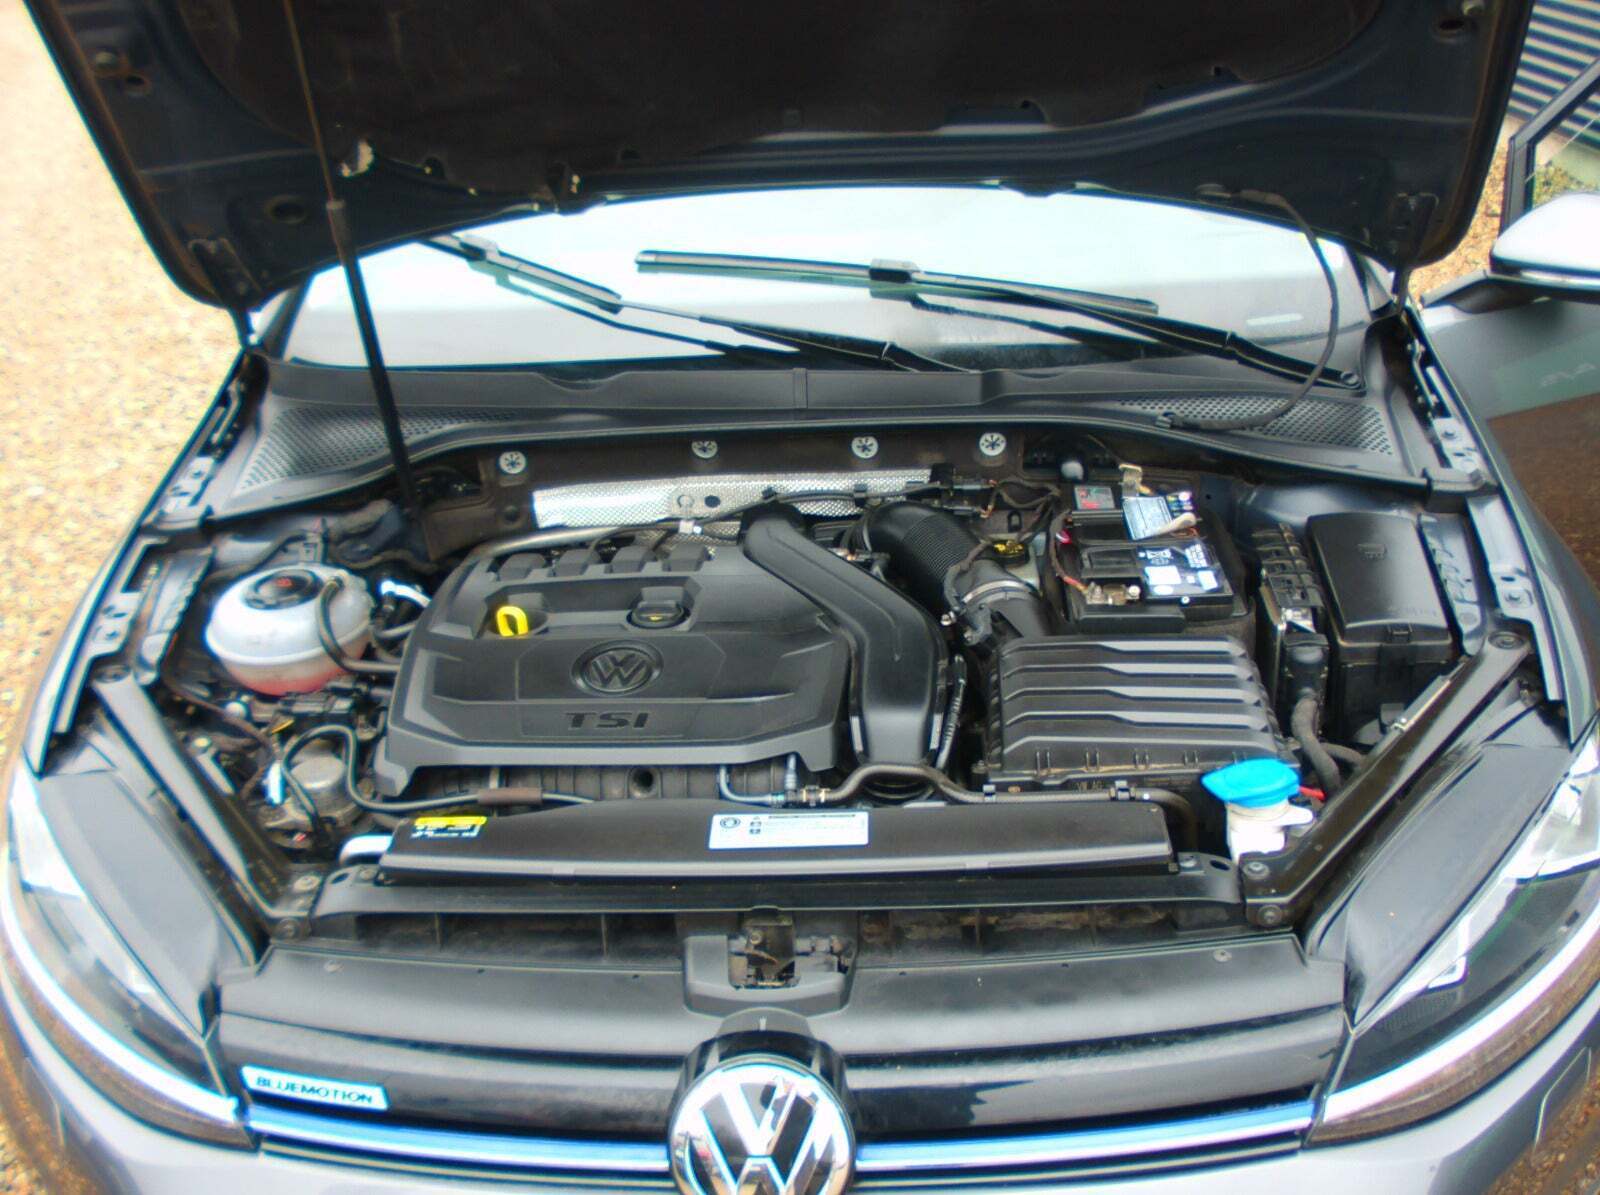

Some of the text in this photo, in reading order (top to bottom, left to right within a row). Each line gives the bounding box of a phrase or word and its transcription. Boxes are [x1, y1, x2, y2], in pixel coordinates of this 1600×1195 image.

[583, 646, 654, 692] VW
[565, 711, 649, 729] TSI
[255, 1075, 373, 1104] BLUEMOTION
[675, 1060, 851, 1195] VW
